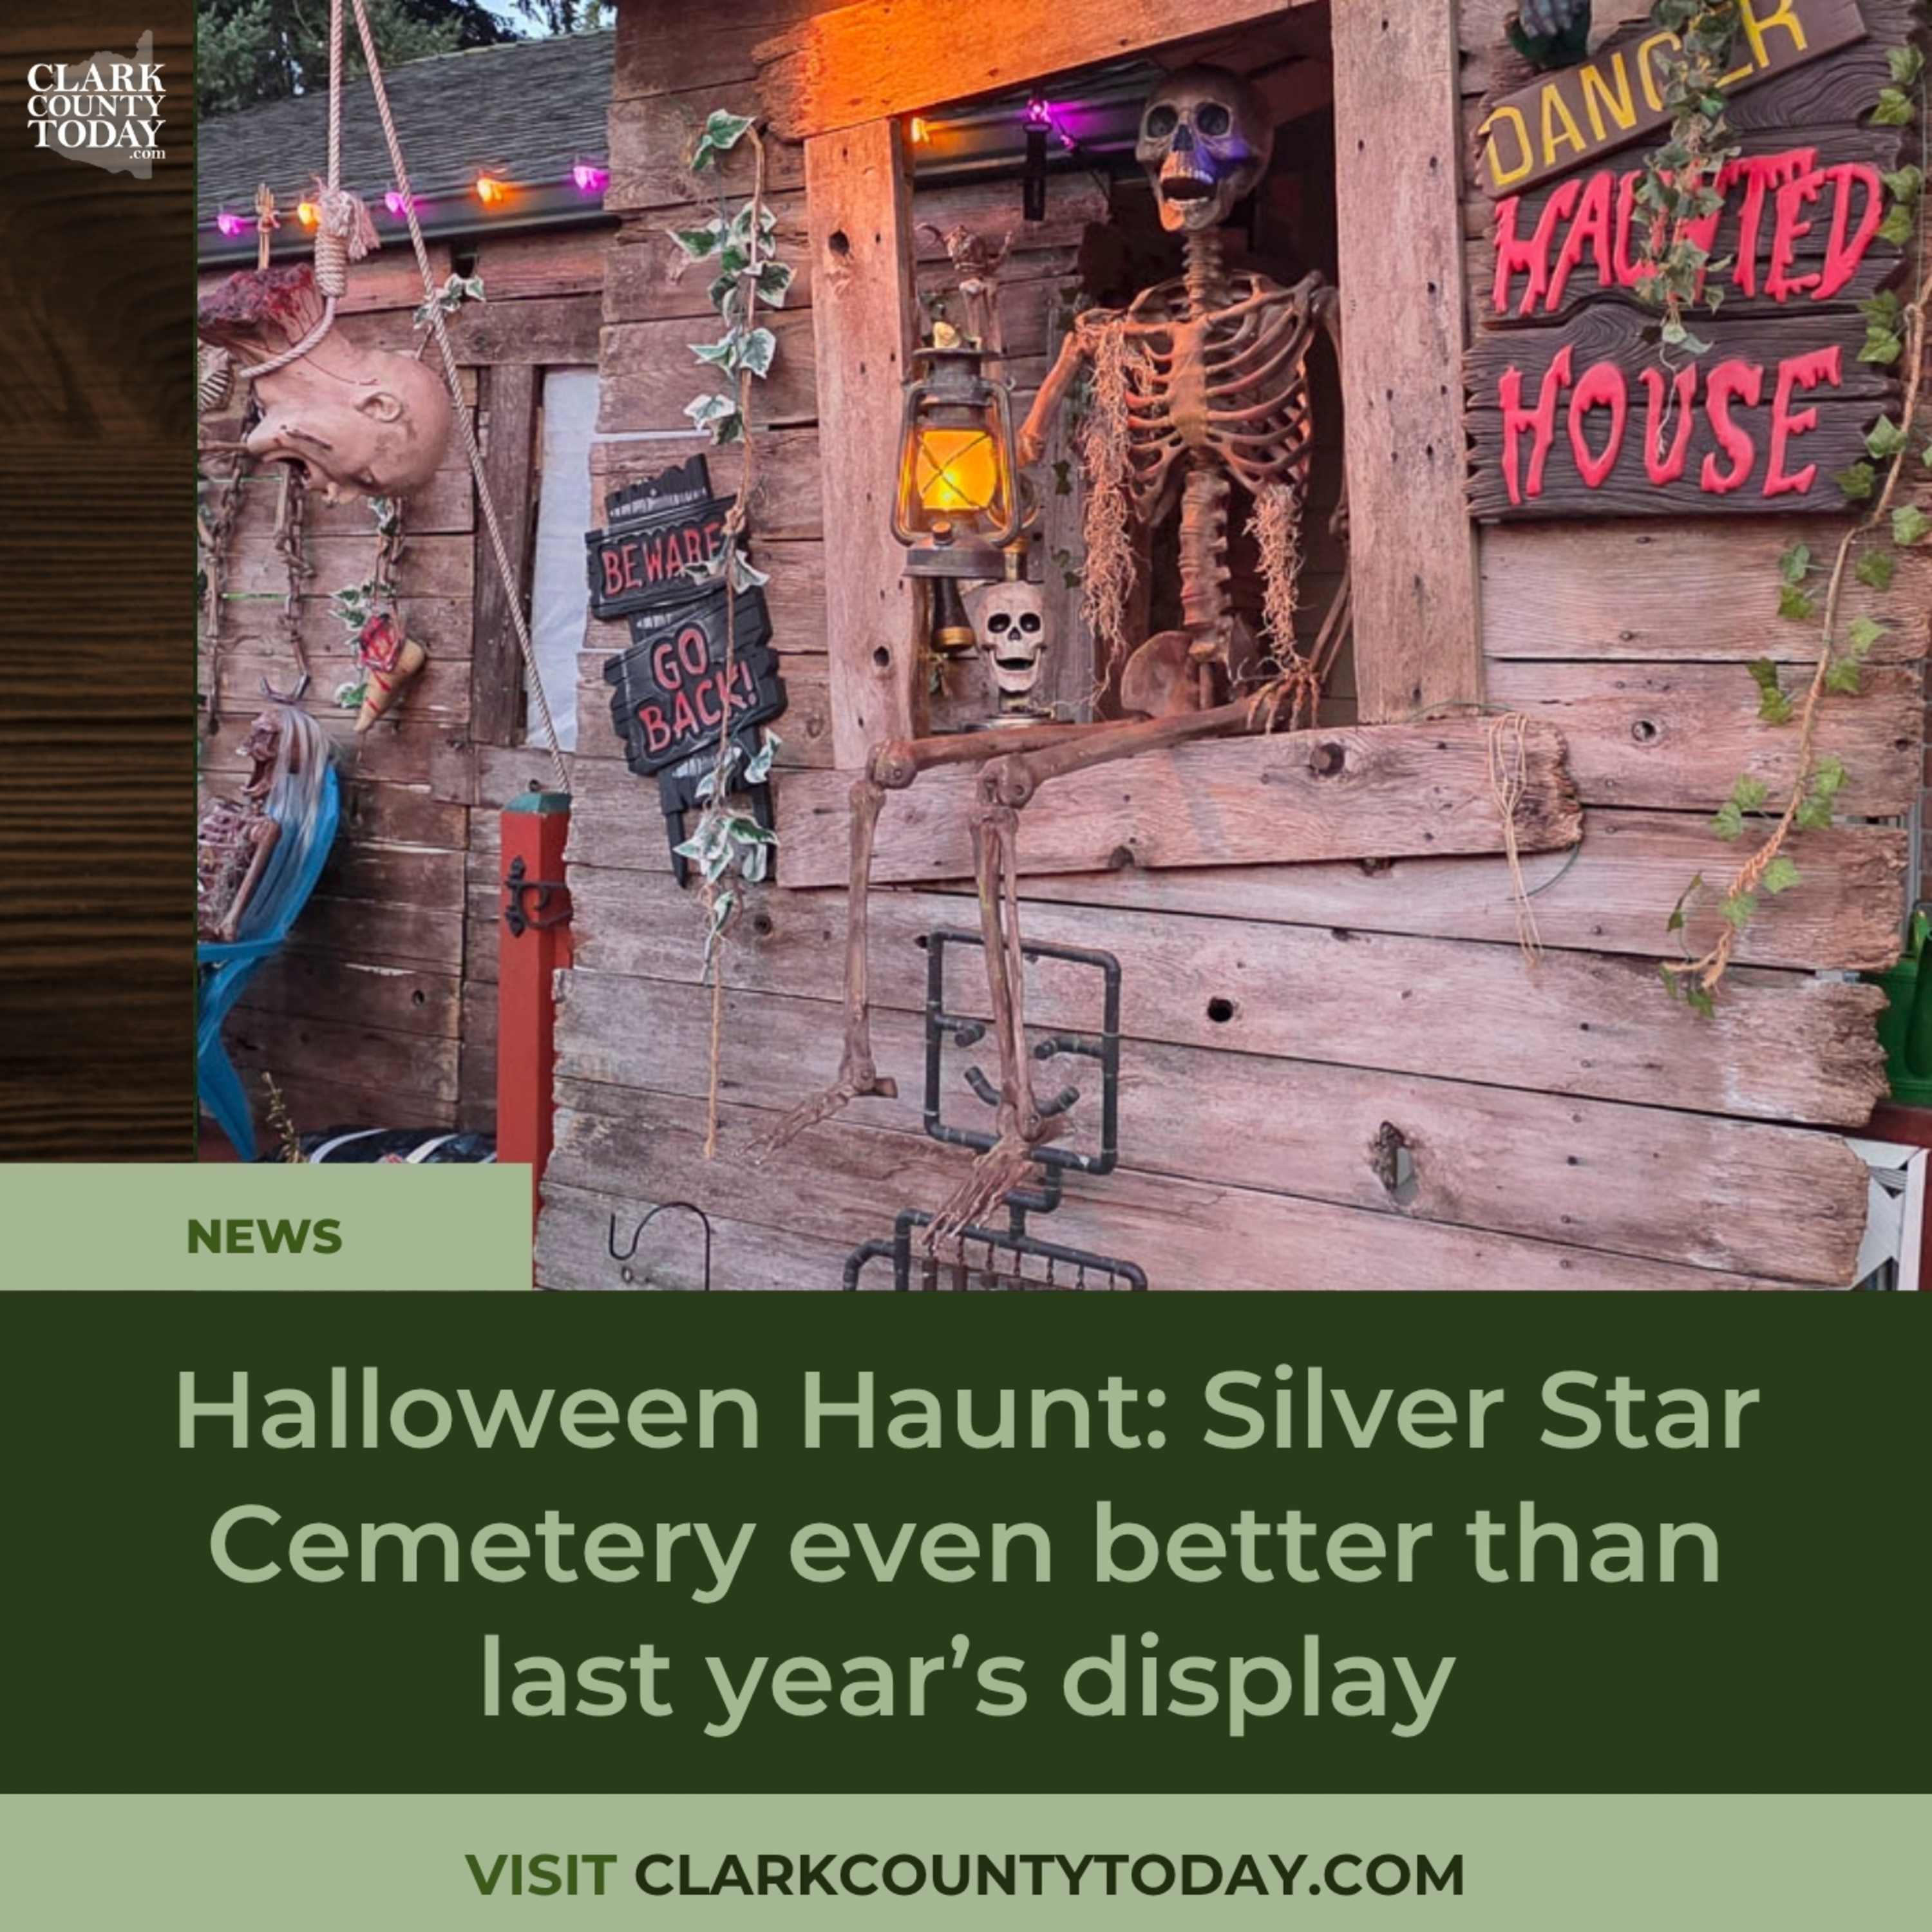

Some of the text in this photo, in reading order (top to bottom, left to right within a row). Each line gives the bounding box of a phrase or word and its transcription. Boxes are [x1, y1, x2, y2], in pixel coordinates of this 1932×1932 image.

[1498, 345, 1842, 505] HOUSE
[601, 521, 723, 596] BEWARE
[653, 628, 708, 690] GO
[638, 660, 757, 753] BACK!
